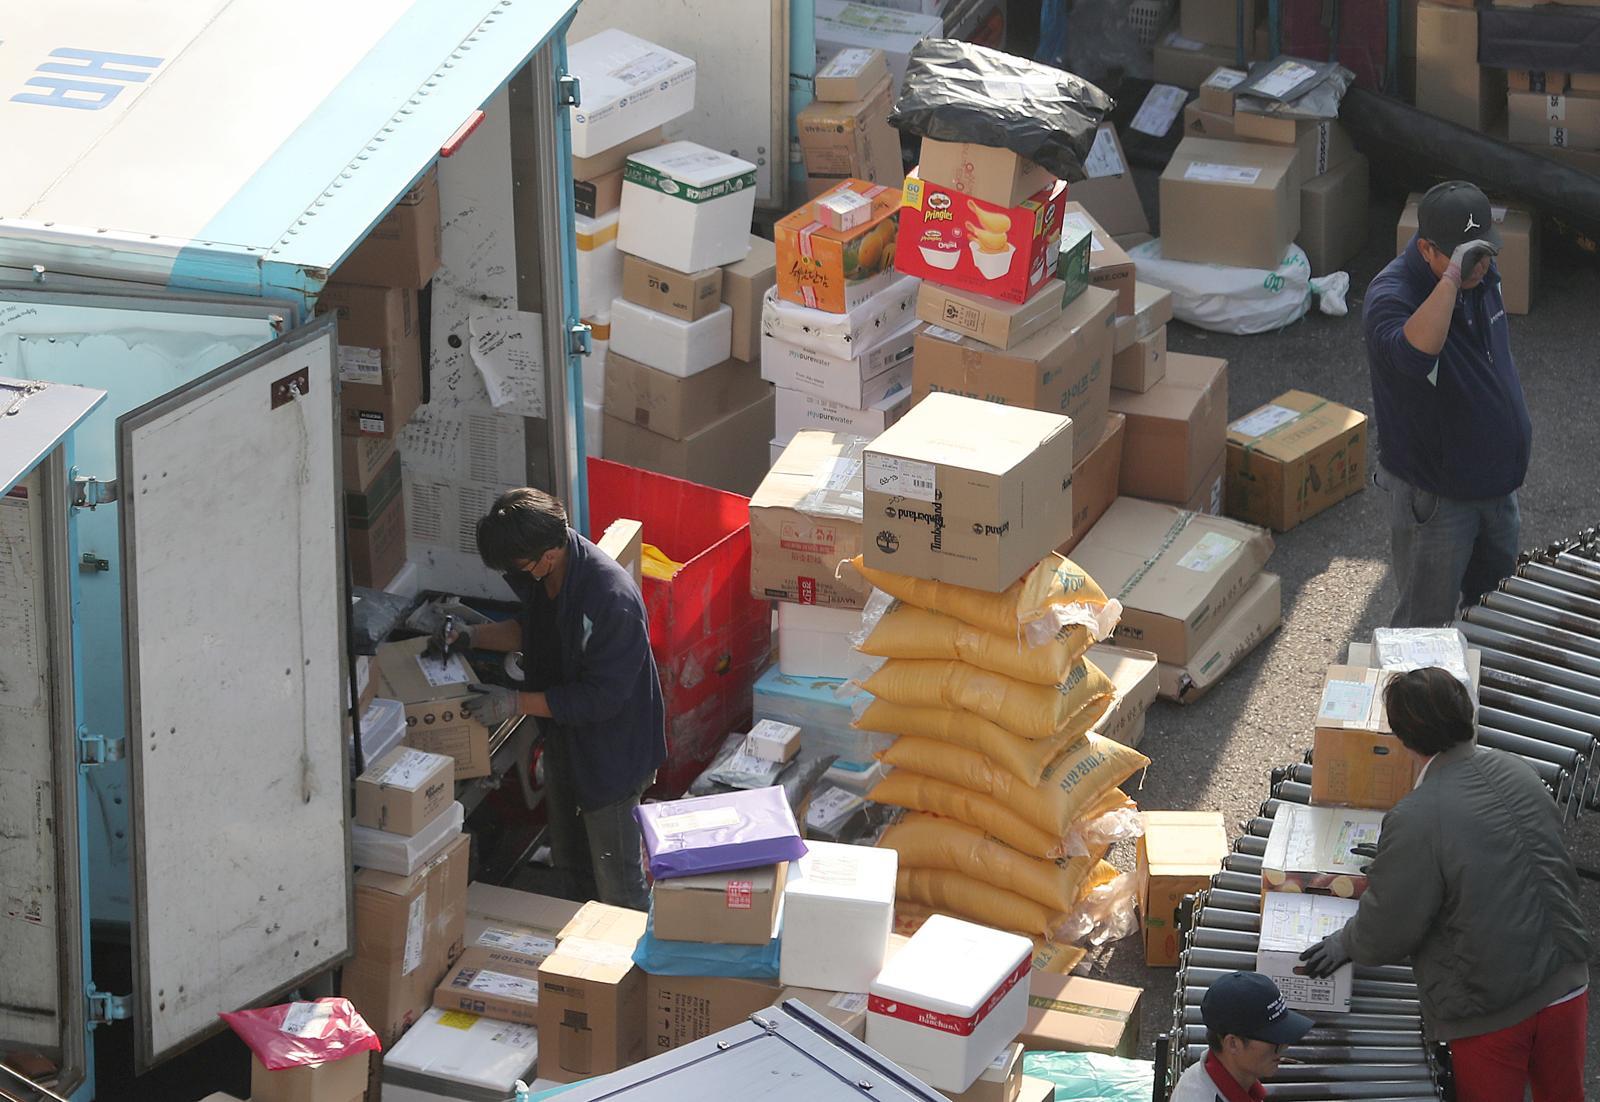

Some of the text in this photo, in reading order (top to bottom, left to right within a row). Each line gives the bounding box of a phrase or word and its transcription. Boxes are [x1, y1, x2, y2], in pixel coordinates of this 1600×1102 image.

[906, 183, 920, 193] 60
[924, 209, 953, 223] Pringles
[648, 280, 661, 290] LG
[806, 408, 854, 426] jejupurewater
[925, 1012, 938, 1022] the
